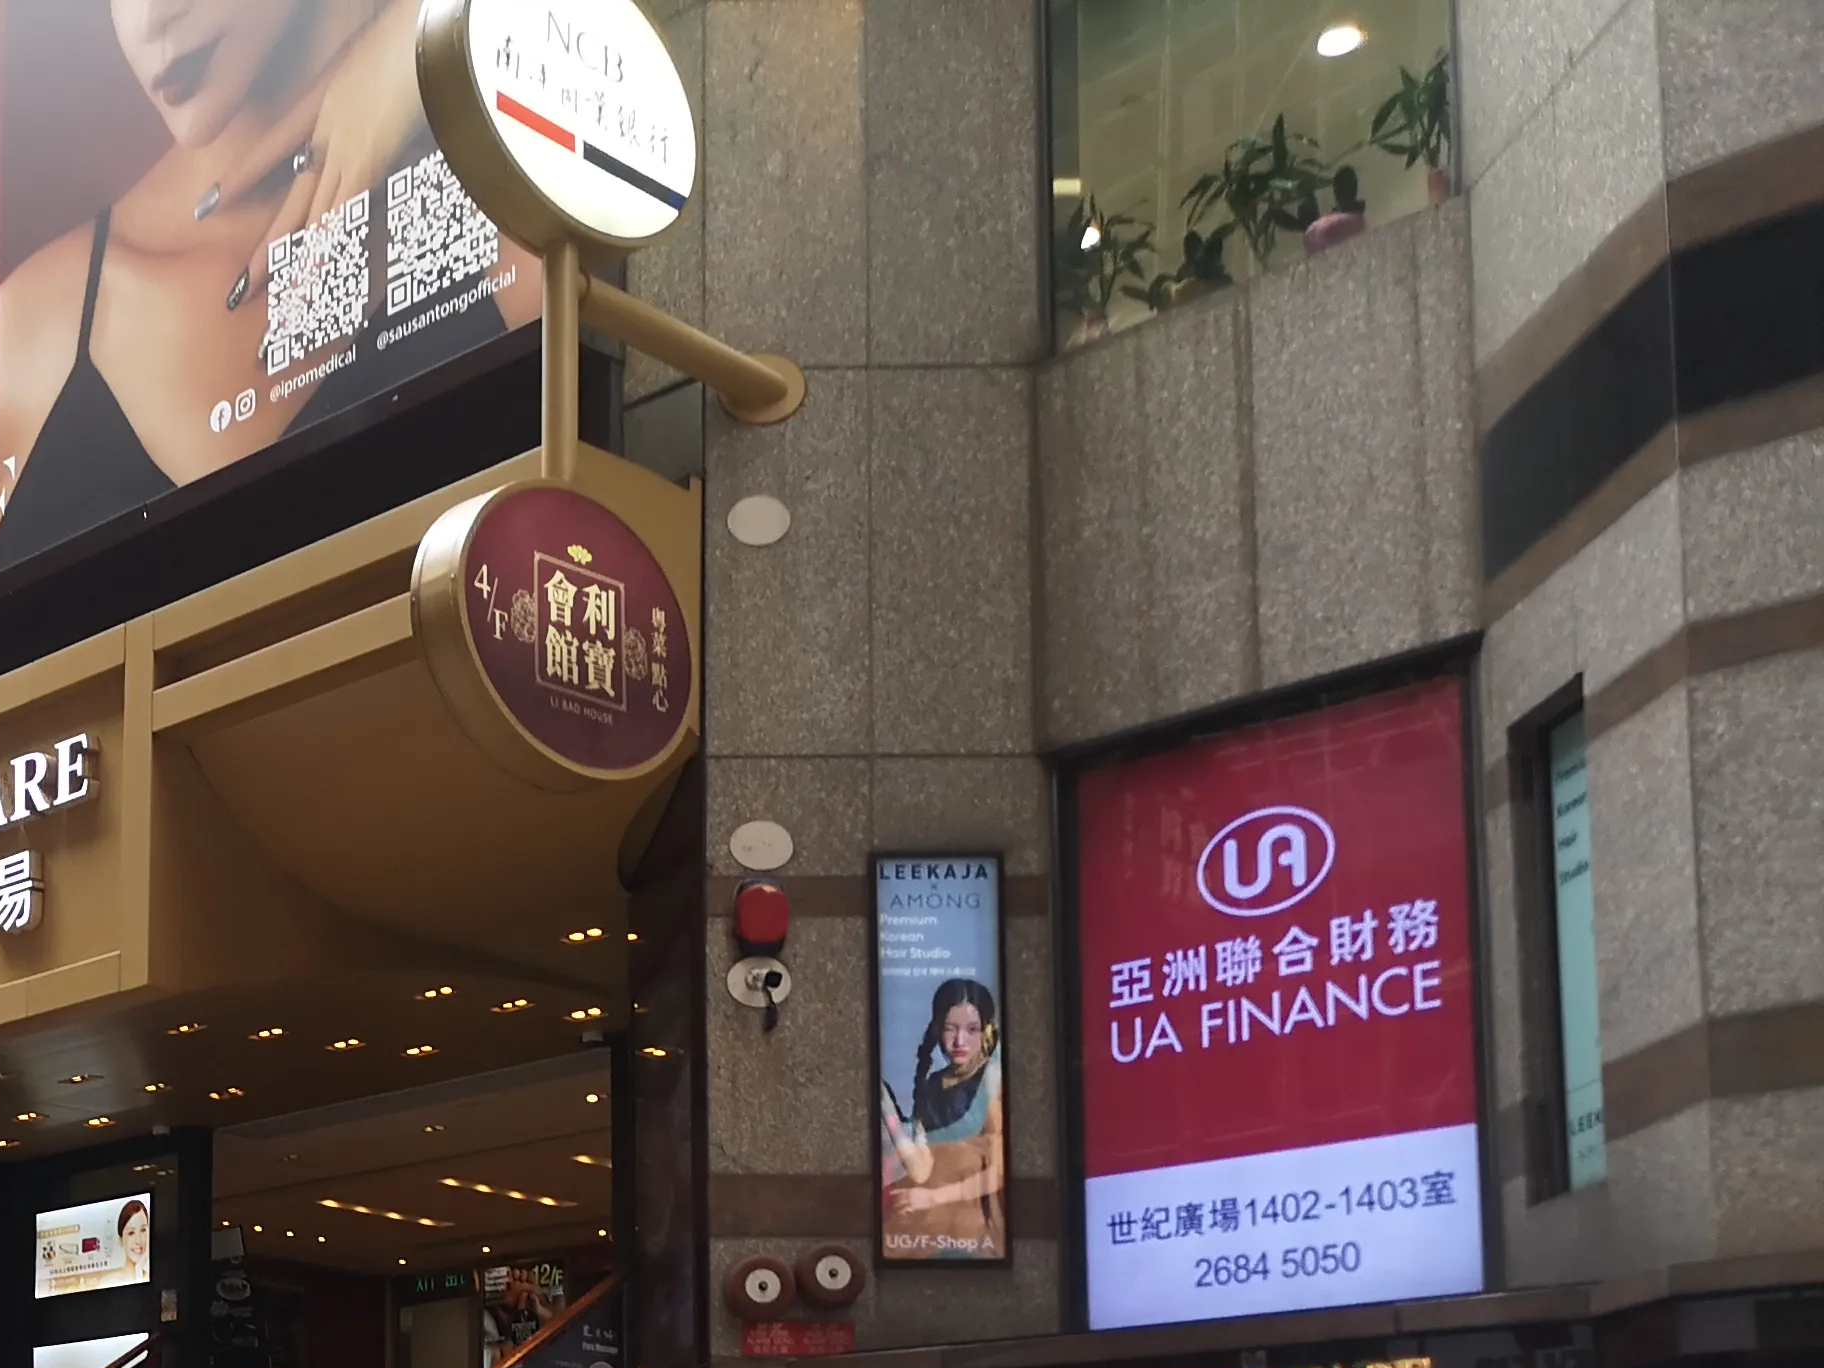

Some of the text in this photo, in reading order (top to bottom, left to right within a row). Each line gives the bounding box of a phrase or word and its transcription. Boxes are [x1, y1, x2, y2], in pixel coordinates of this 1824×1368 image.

[496, 35, 668, 164] 南商業銀行
[376, 265, 516, 350] @sausantongofficial
[270, 344, 356, 402] @ipromedical
[474, 564, 509, 641] 4/F
[879, 863, 988, 880] LEEKAJA
[879, 913, 938, 926] Premium
[879, 931, 924, 942] Korean
[880, 947, 951, 959] Hair Studio
[1109, 898, 1440, 1009] 亞洲聯合財務
[1111, 960, 1442, 1064] UA FINANCE
[1107, 1170, 1457, 1247] 世紀廣場1402-1403室
[981, 1234, 994, 1249] A
[1194, 1240, 1361, 1289] 2684 5050
[532, 1263, 564, 1286] 12/F
